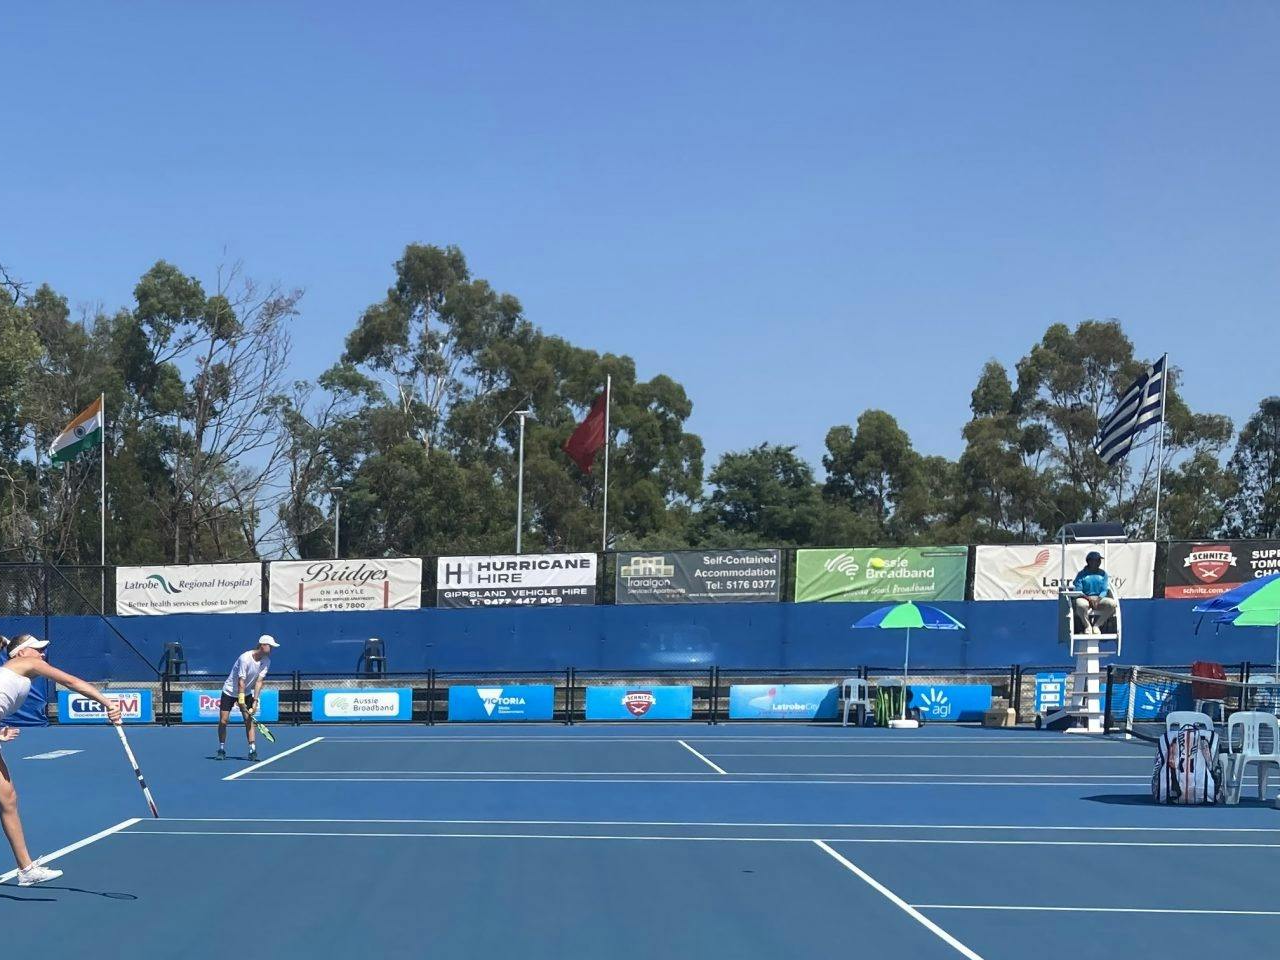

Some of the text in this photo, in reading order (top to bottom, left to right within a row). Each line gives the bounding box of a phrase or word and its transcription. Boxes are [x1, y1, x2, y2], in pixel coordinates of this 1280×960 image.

[703, 555, 777, 565] Self-Contained
[1193, 552, 1229, 560] SCHNITZ
[477, 559, 591, 572] HURRICANE
[867, 557, 909, 568] Assie
[300, 562, 389, 587] Bridges
[477, 573, 522, 584] HIRE
[694, 568, 777, 578] Accommodation
[866, 567, 935, 579] Broadband
[124, 578, 253, 591] Latrobe Regional Hospital
[705, 579, 776, 590] Tel: 5176 0377
[320, 588, 365, 596] ON ARGYLE
[444, 590, 507, 599] GIPPSLAND
[511, 588, 558, 597] VEHICLE
[128, 601, 149, 609] Better
[150, 600, 171, 608] health
[173, 600, 200, 608] services
[201, 599, 218, 607] close
[229, 598, 249, 606] home
[482, 697, 526, 705] VICTORIA
[353, 704, 394, 712] Broadband
[932, 704, 951, 718] agl
